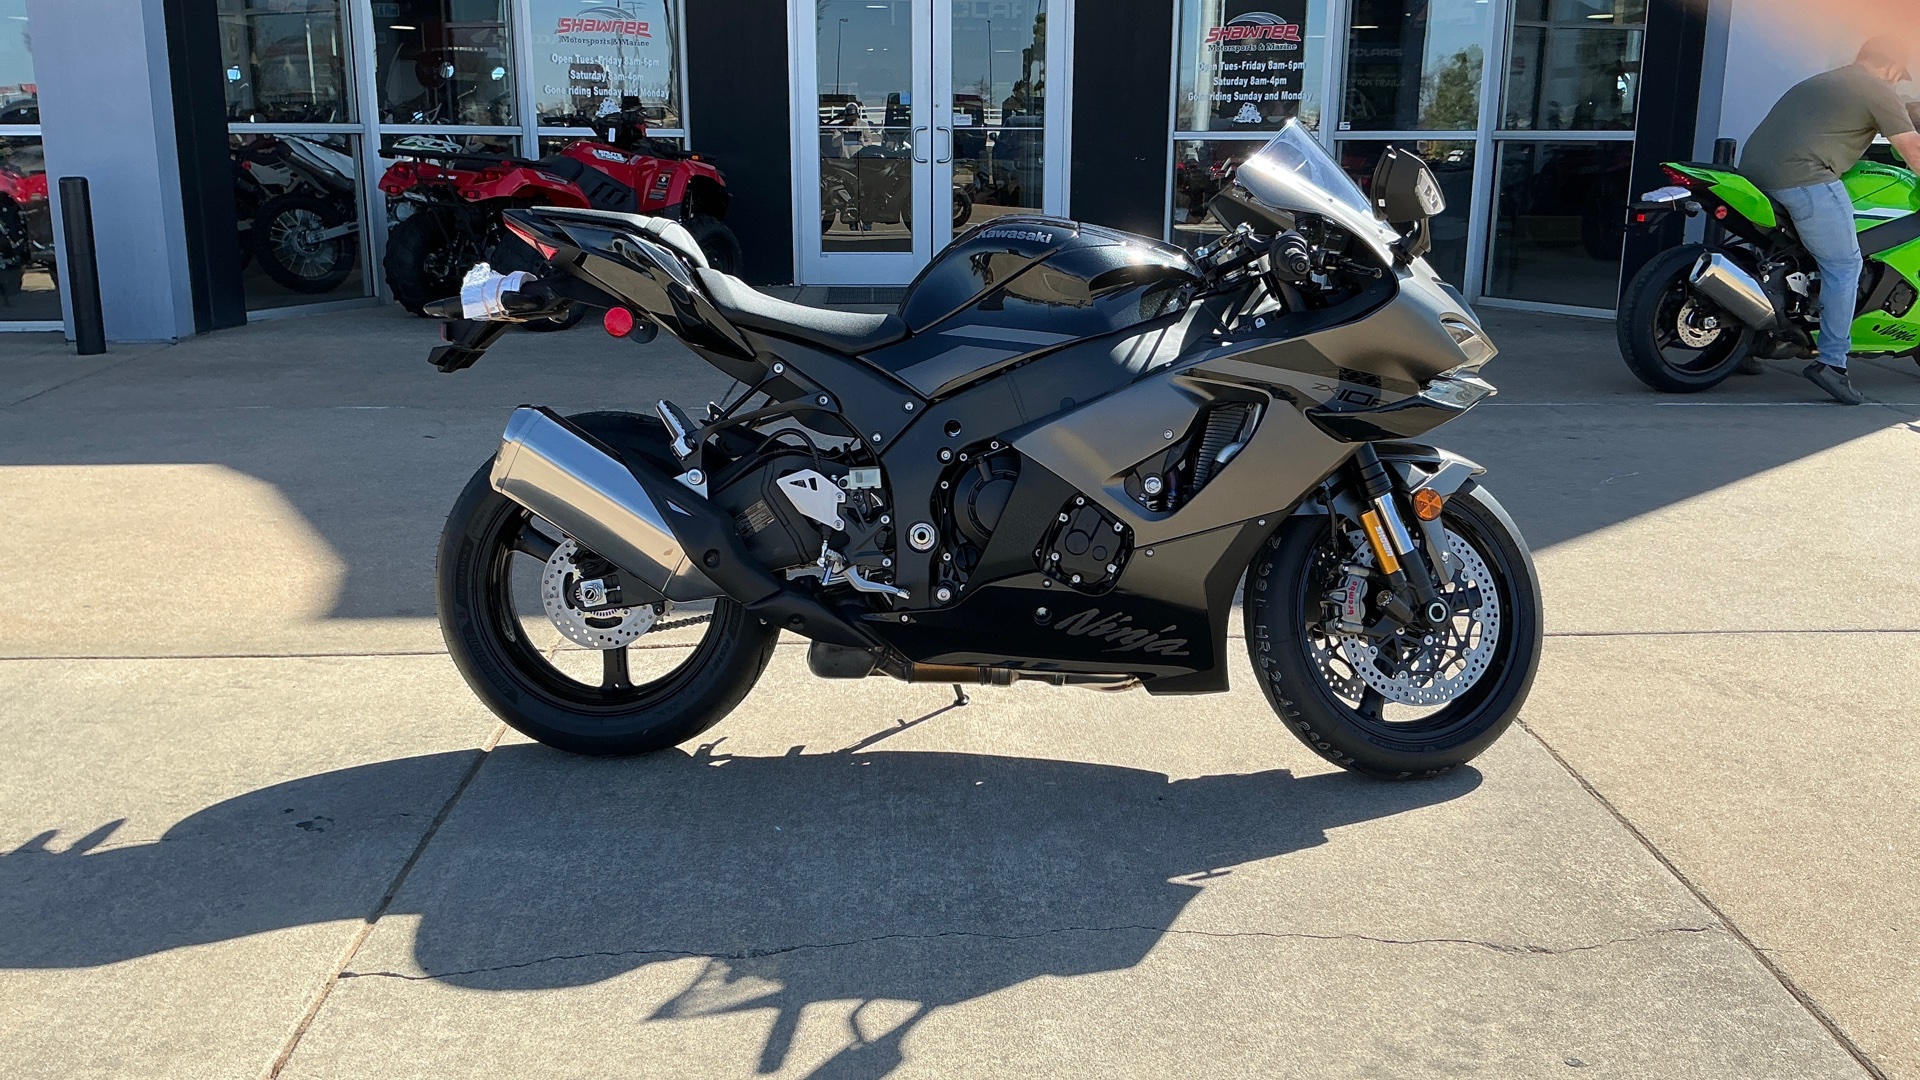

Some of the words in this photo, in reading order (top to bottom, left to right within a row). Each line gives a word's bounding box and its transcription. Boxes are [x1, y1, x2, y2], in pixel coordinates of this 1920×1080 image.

[559, 35, 611, 47] Motorsports
[621, 38, 650, 47] Marine
[1208, 43, 1257, 53] Motorsports
[1258, 44, 1265, 52] &
[1266, 42, 1298, 51] Marine
[551, 53, 573, 66] Open
[575, 54, 623, 68] Tues-Friday
[1220, 61, 1267, 73] Tues-Friday
[1267, 61, 1307, 73] 8am-6pm
[570, 69, 607, 83] Saturday
[608, 72, 645, 84] 8am-4pm
[1212, 76, 1249, 88] Saturday
[1250, 76, 1287, 88] 8am-4pm
[544, 85, 566, 96] Gone
[568, 85, 592, 98] riding
[593, 86, 623, 99] Sunday
[624, 87, 639, 97] and
[640, 88, 670, 100] Monday
[1210, 92, 1232, 103] riding
[1233, 91, 1263, 103] Sunday
[1264, 91, 1279, 101] and
[1280, 91, 1313, 103] Monday
[1859, 169, 1897, 178] Kawasaki
[977, 229, 1054, 244] Kawasaki
[1877, 323, 1917, 341] Ninja
[1374, 525, 1395, 557] SHOWA
[1346, 580, 1358, 616] brembo
[1053, 608, 1190, 656] Ninja
